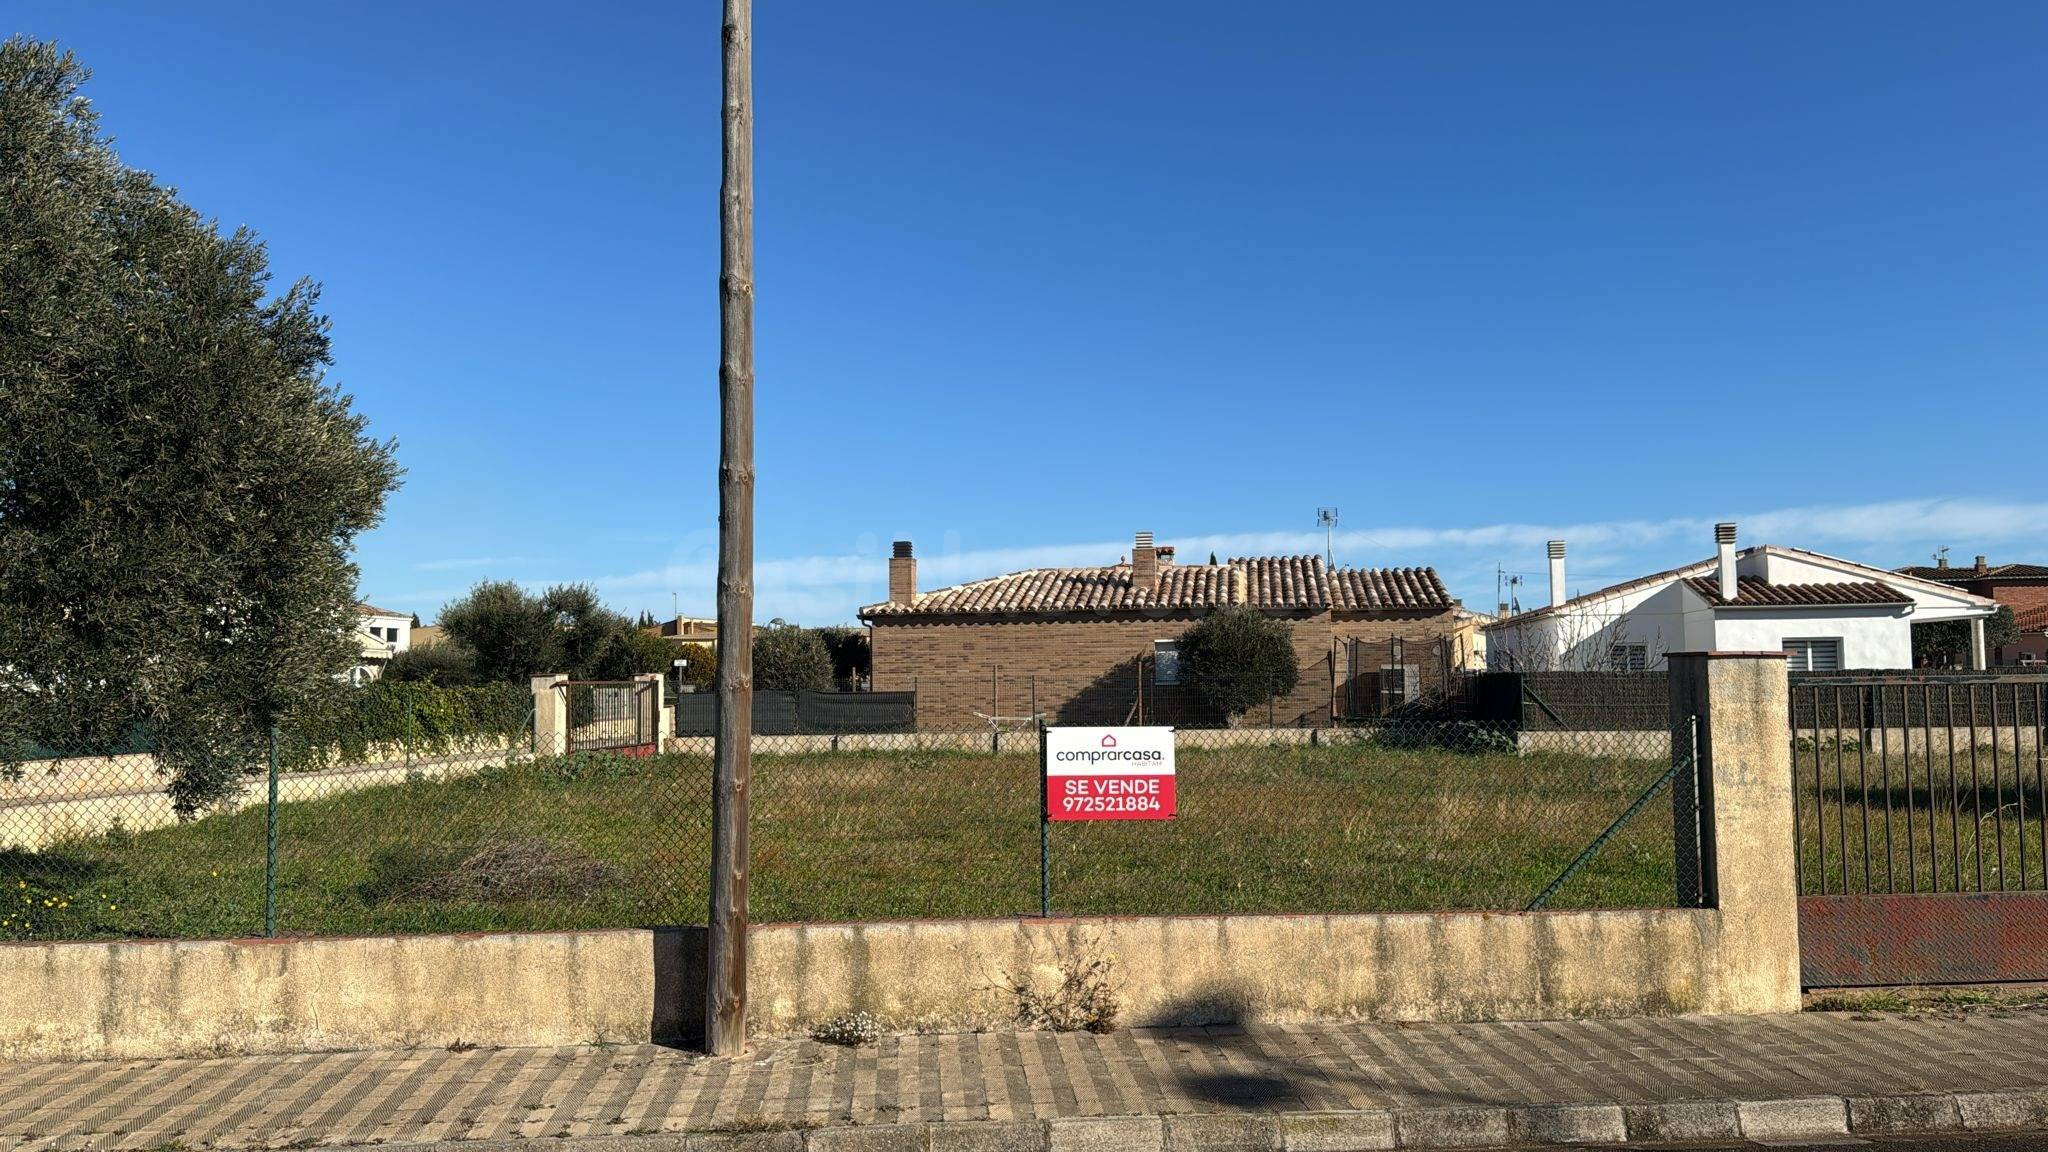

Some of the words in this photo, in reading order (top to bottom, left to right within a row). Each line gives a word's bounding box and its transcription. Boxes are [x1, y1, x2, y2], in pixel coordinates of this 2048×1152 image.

[1065, 779, 1089, 794] SE
[1094, 779, 1160, 794] VENDE
[1063, 796, 1160, 812] 972521884
